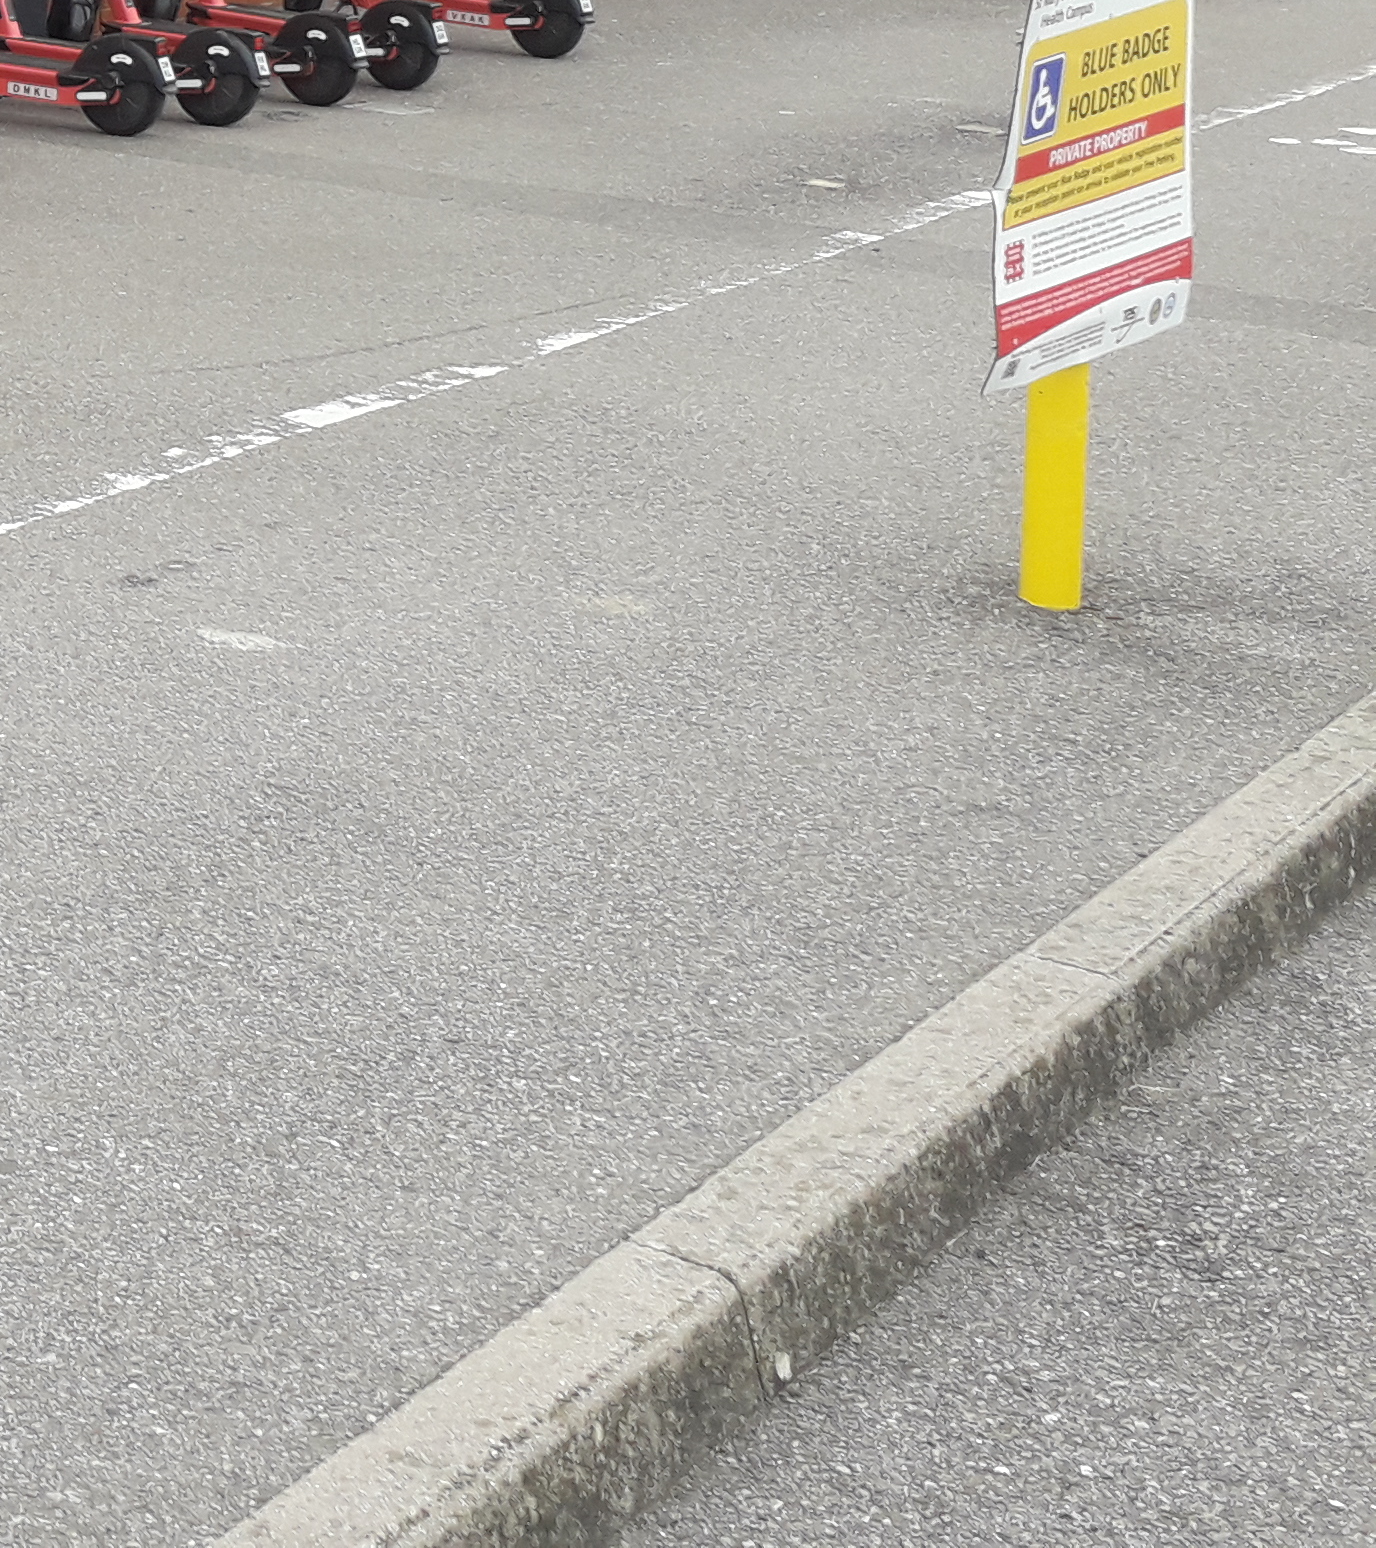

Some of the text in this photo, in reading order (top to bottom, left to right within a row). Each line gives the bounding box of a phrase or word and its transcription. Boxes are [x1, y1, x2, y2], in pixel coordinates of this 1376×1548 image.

[1081, 25, 1170, 78] BLUE BADGE
[1066, 63, 1182, 123] HOLDERS ONLY
[1049, 119, 1148, 168] PRIVATE PROPERTY
